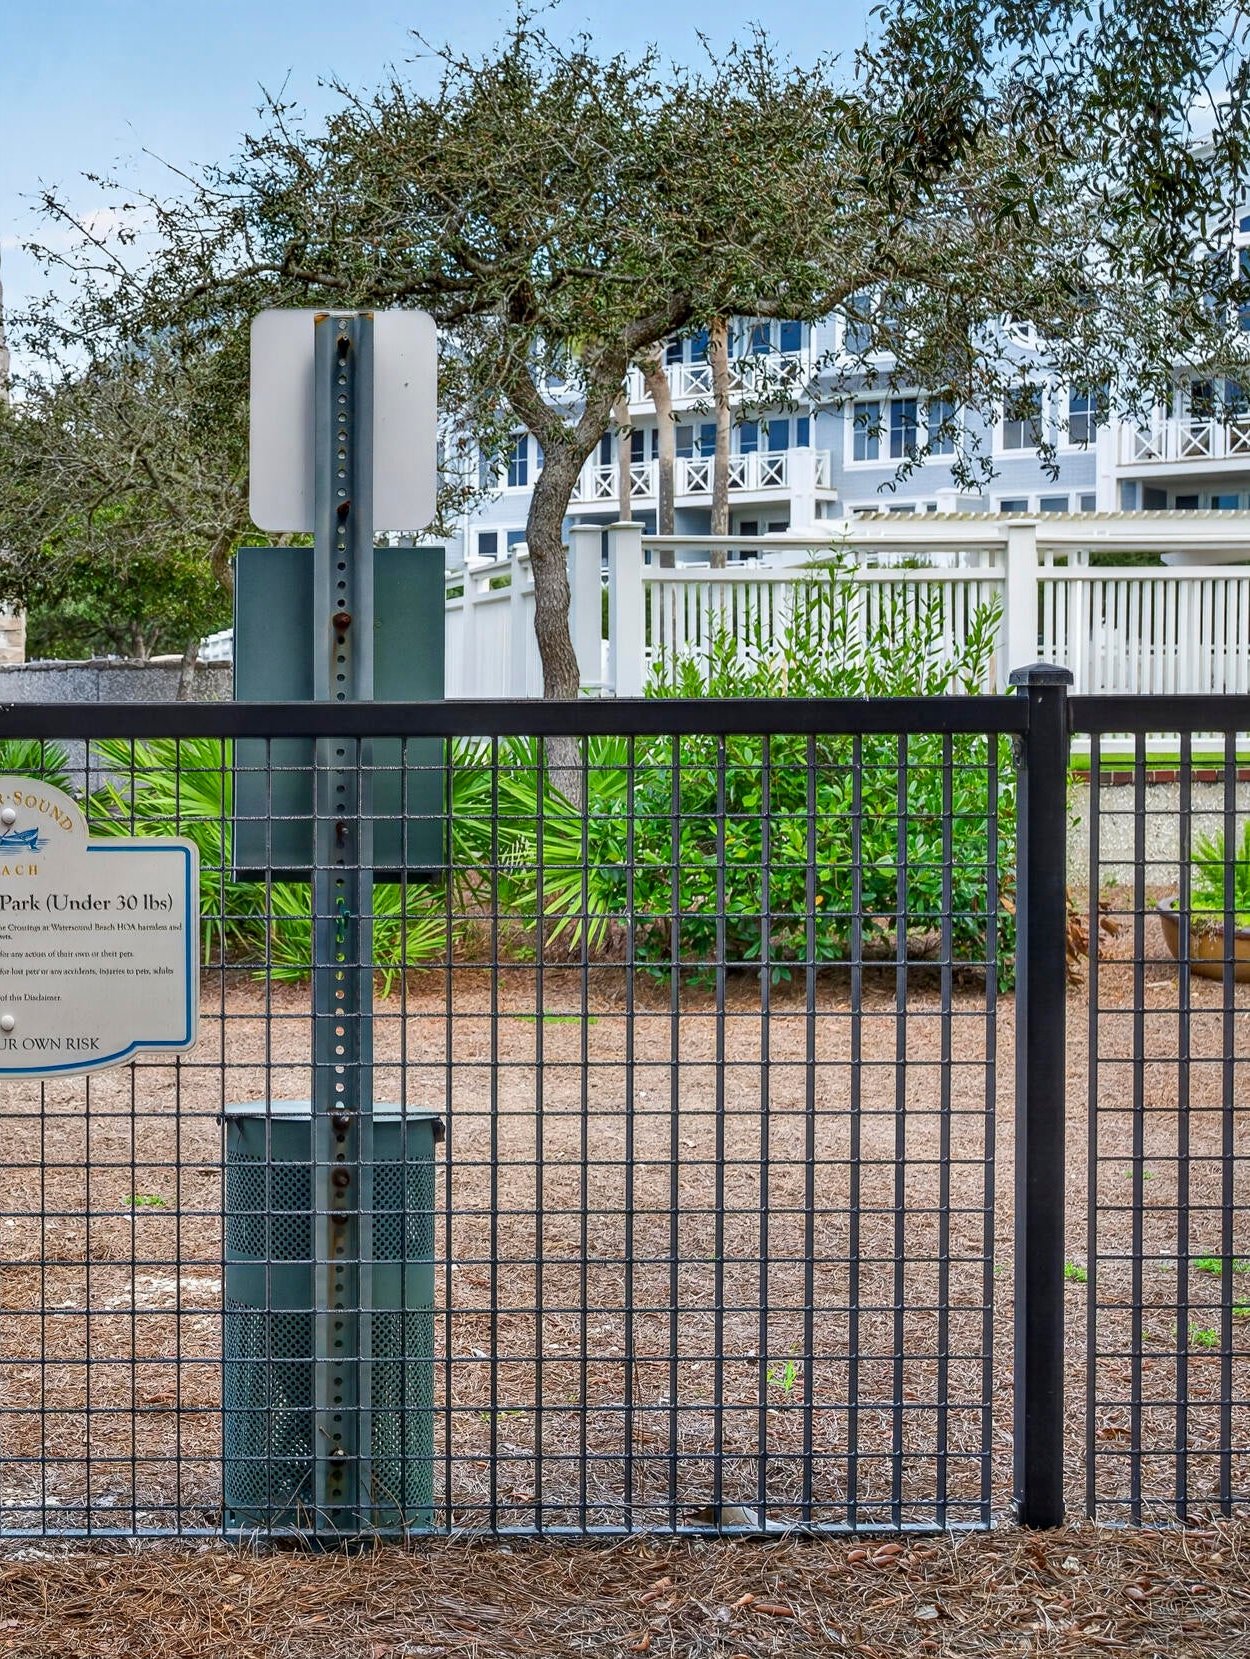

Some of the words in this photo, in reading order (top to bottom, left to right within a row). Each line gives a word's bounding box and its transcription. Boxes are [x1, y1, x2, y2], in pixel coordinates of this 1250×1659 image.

[0, 894, 40, 911] Park
[46, 893, 111, 912] (Under
[116, 895, 138, 911] 30
[143, 893, 173, 912] lbs)
[7, 923, 41, 933] Crossings
[50, 923, 93, 931] Watersound
[94, 923, 115, 931] Beach
[116, 923, 136, 931] HOA
[137, 922, 168, 931] harmless
[168, 922, 182, 931] and
[64, 967, 98, 976] accidents,
[99, 967, 126, 976] injuries
[152, 966, 174, 974] adults
[9, 993, 23, 1001] this
[24, 993, 62, 1001] Disclaimer.
[22, 1037, 61, 1050] OWN
[66, 1037, 101, 1050] RISK
